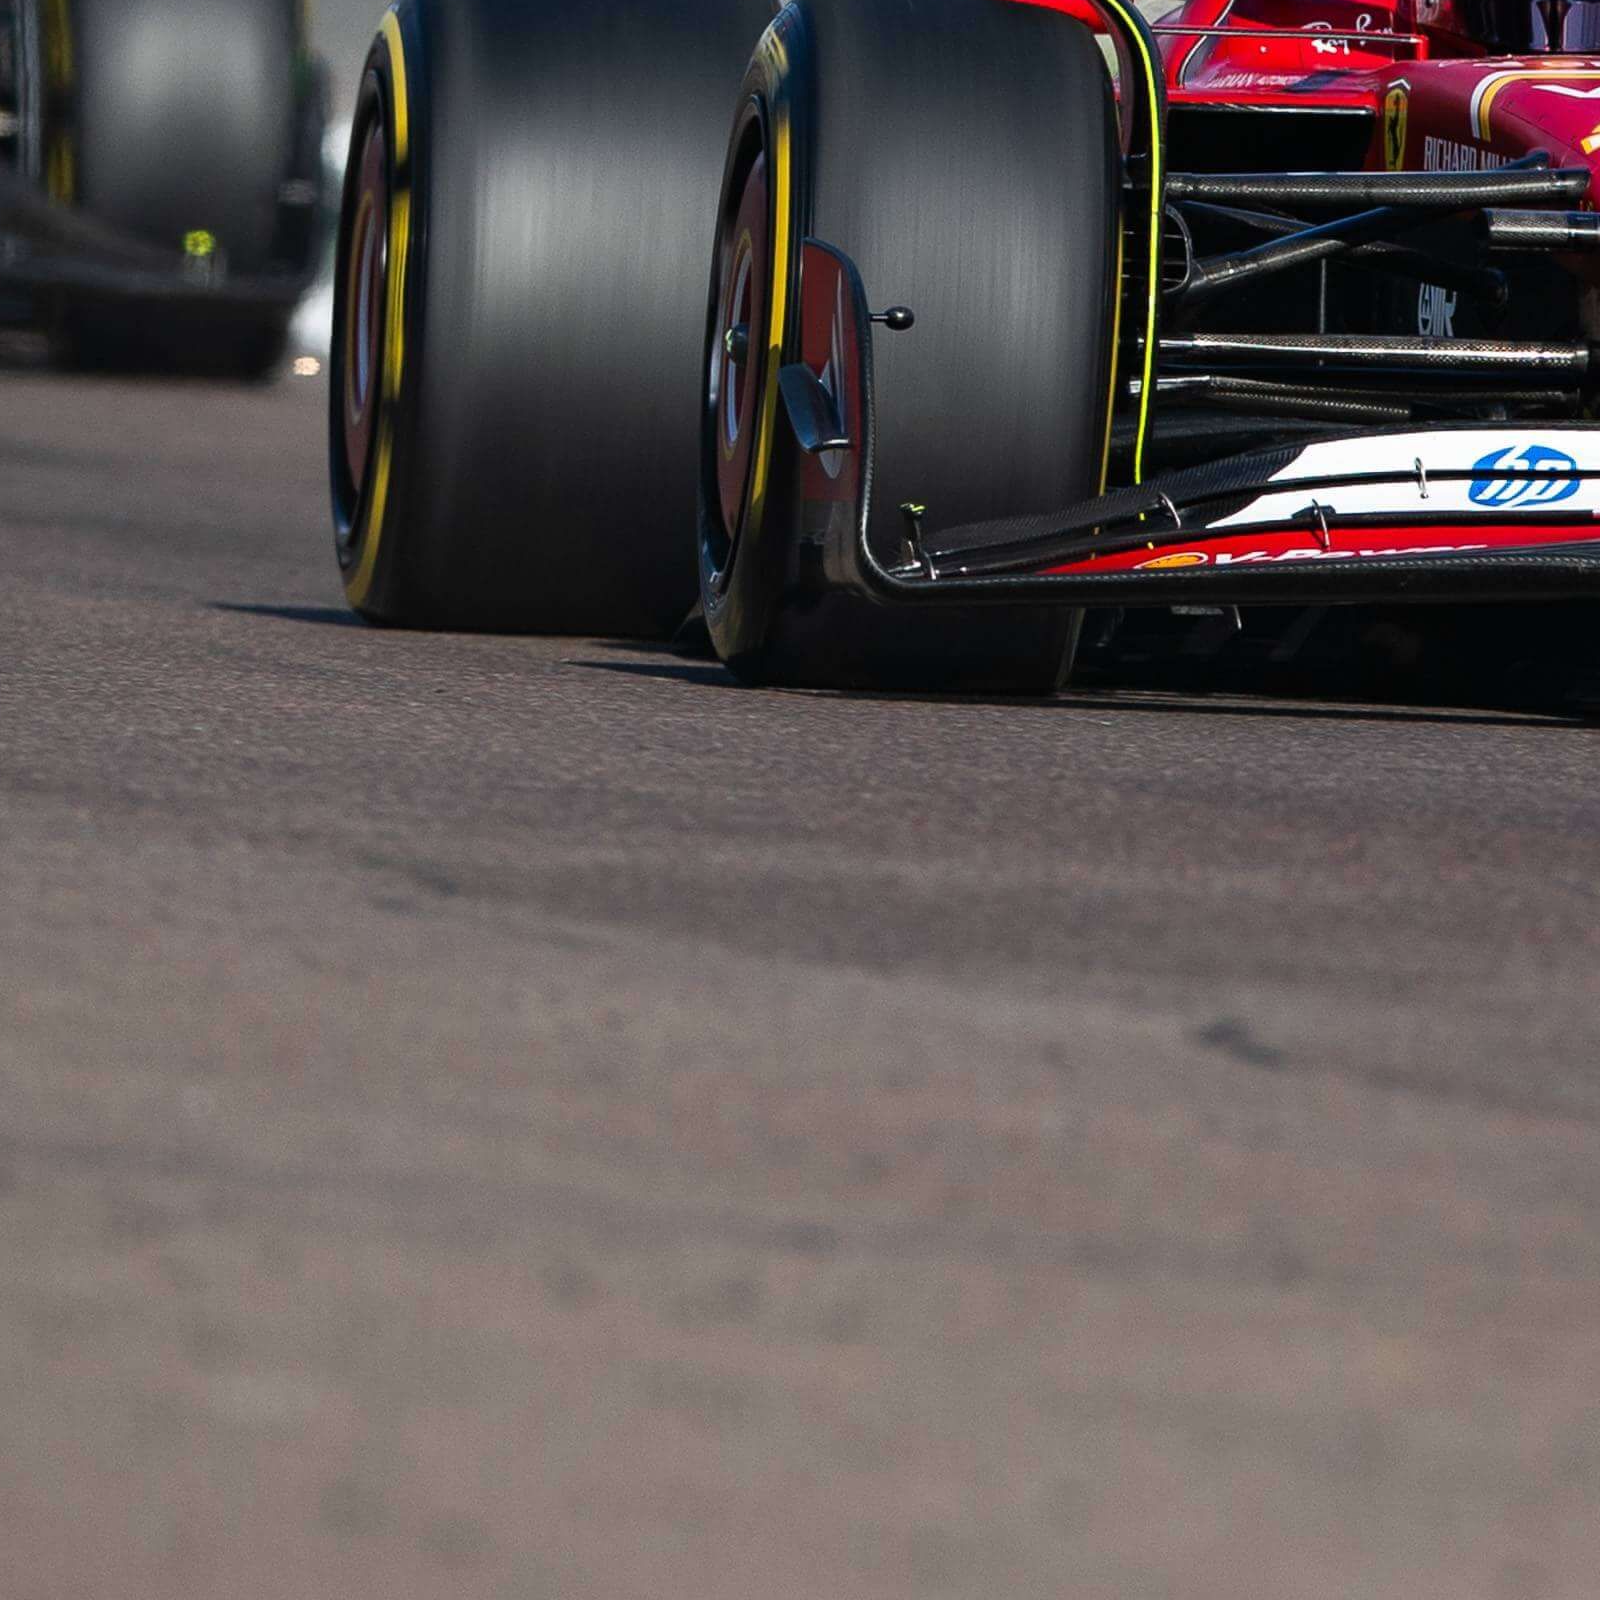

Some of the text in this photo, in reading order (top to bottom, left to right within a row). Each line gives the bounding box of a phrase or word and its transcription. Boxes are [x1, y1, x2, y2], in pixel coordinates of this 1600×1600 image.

[1424, 136, 1515, 171] RICHARD MIL
[1470, 445, 1578, 507] hp
